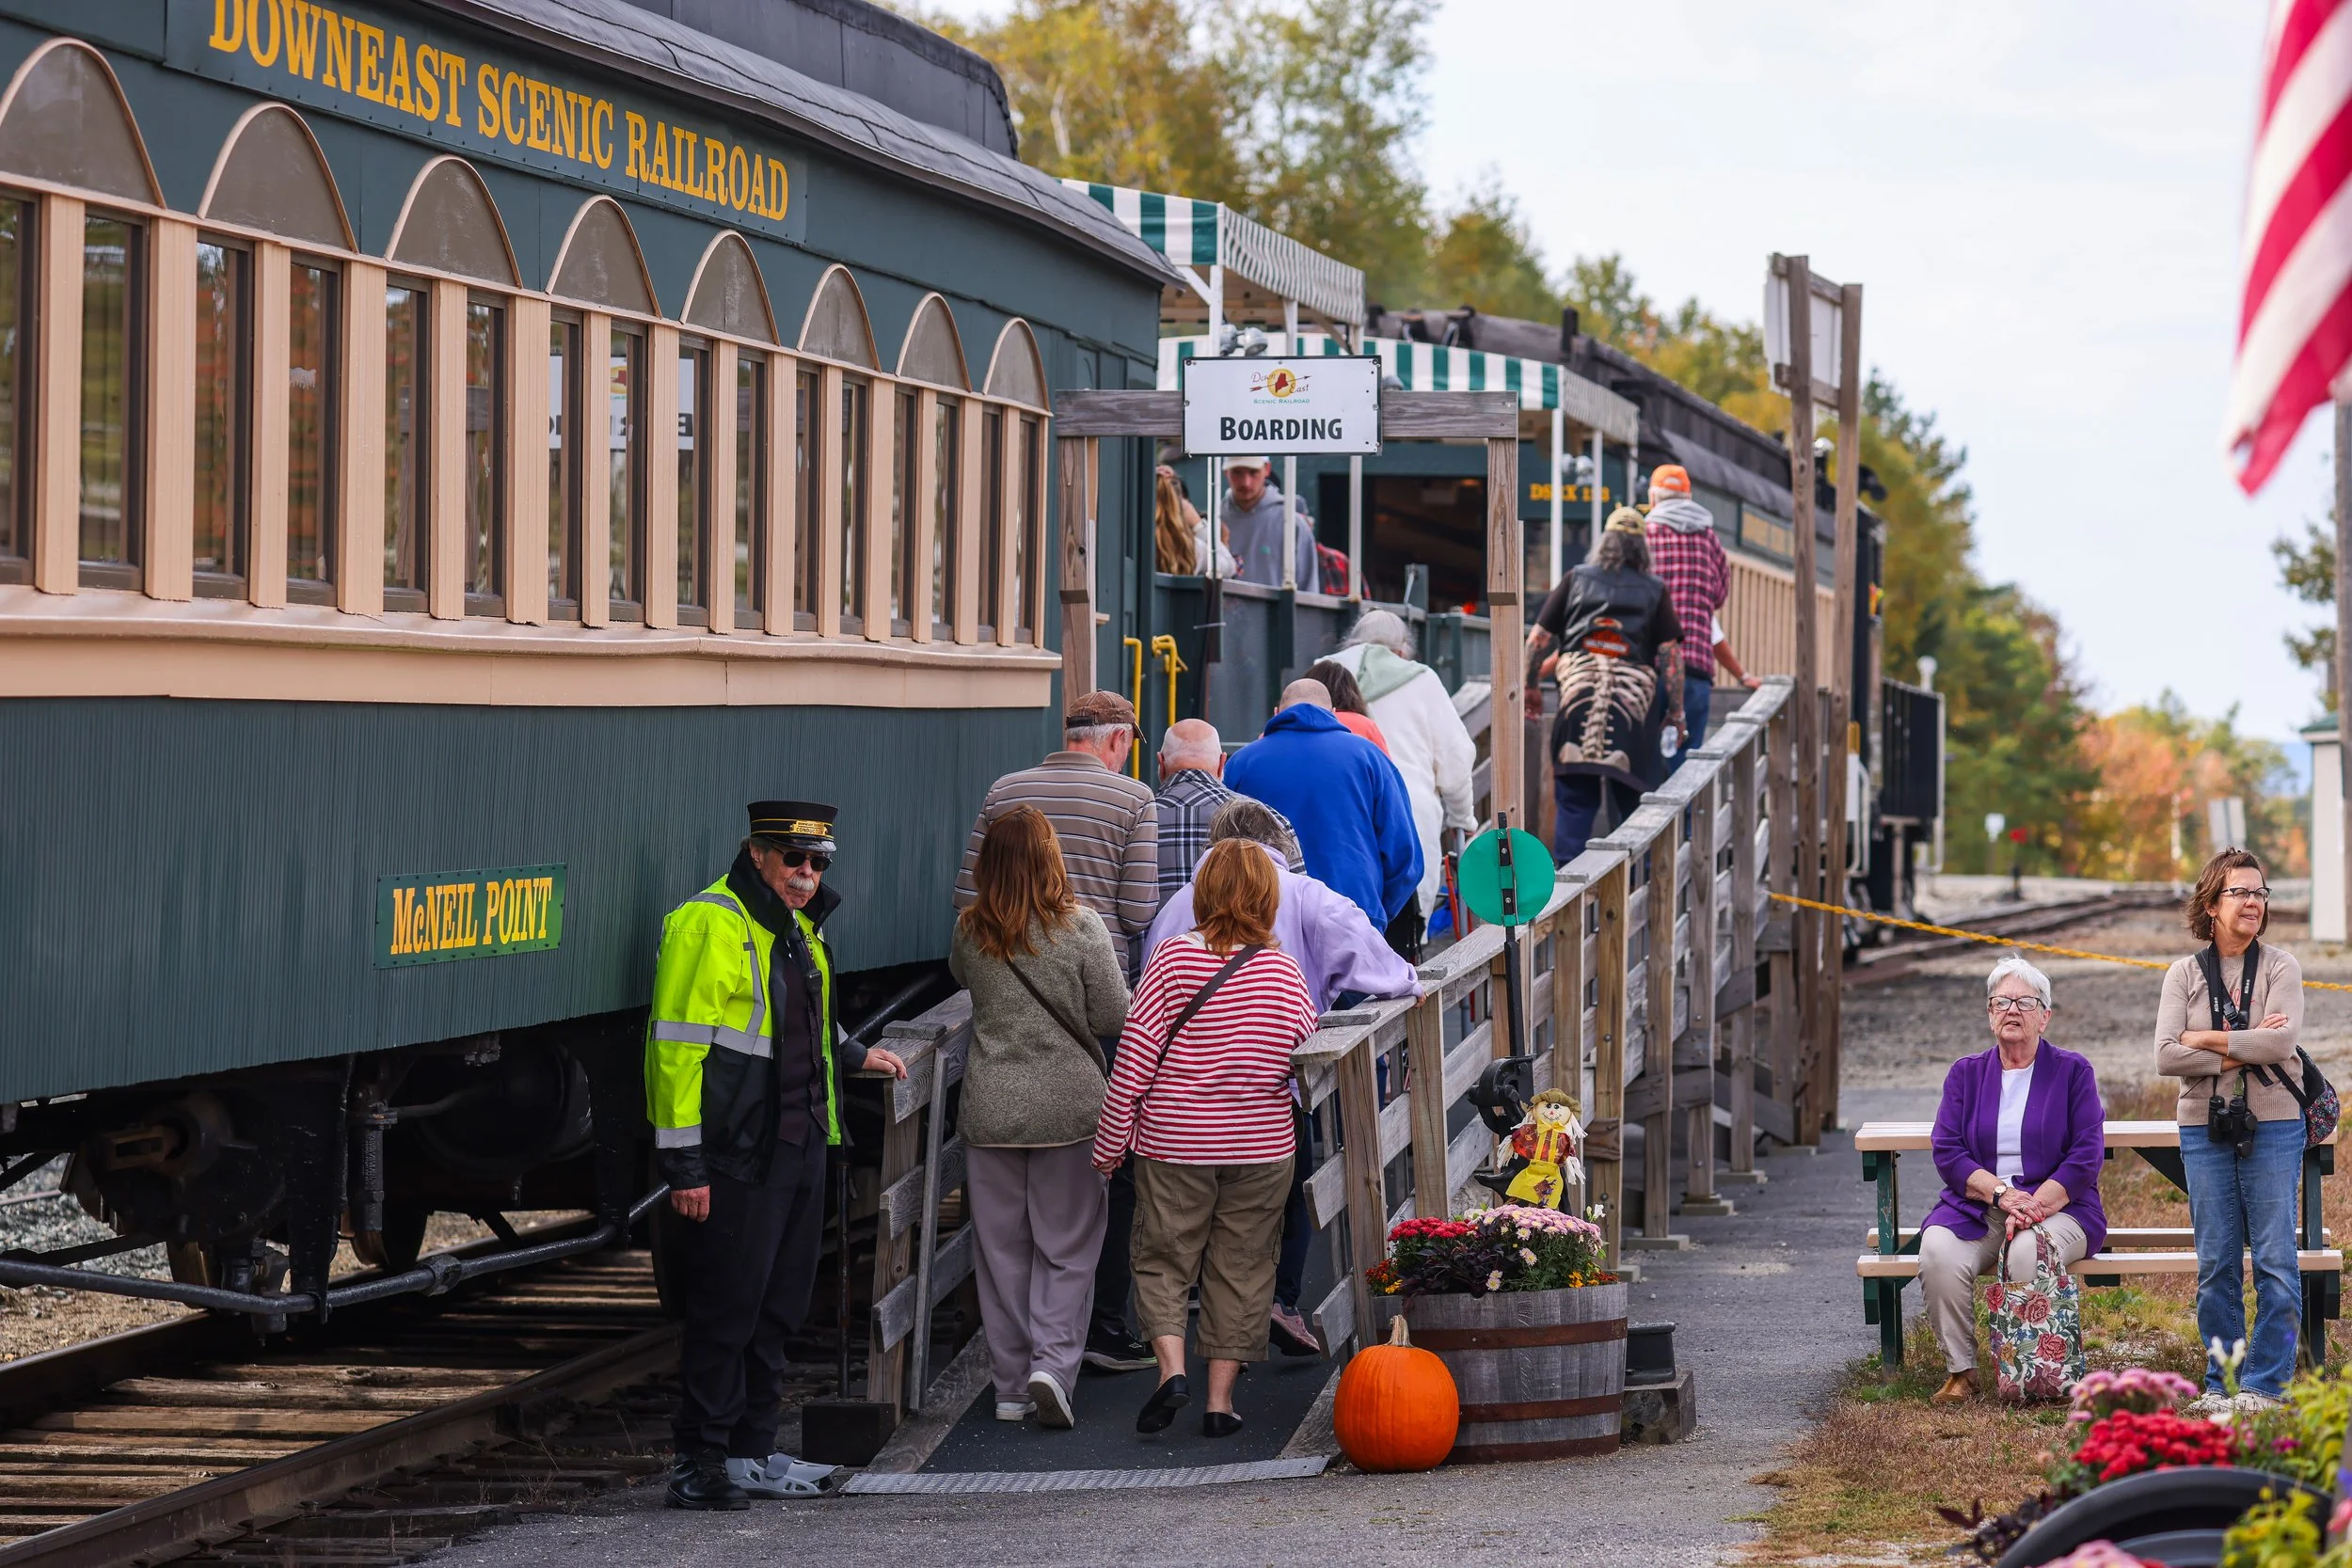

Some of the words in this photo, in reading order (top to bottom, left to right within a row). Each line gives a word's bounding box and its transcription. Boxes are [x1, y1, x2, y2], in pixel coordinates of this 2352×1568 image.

[209, 0, 466, 128] DOWNEAST
[477, 63, 613, 170] SCENIC
[625, 110, 789, 222] RAILROAD
[1290, 382, 1310, 394] East
[1220, 417, 1343, 440] BOARDING
[390, 883, 478, 955] McNEIL
[483, 878, 553, 945] POINT
